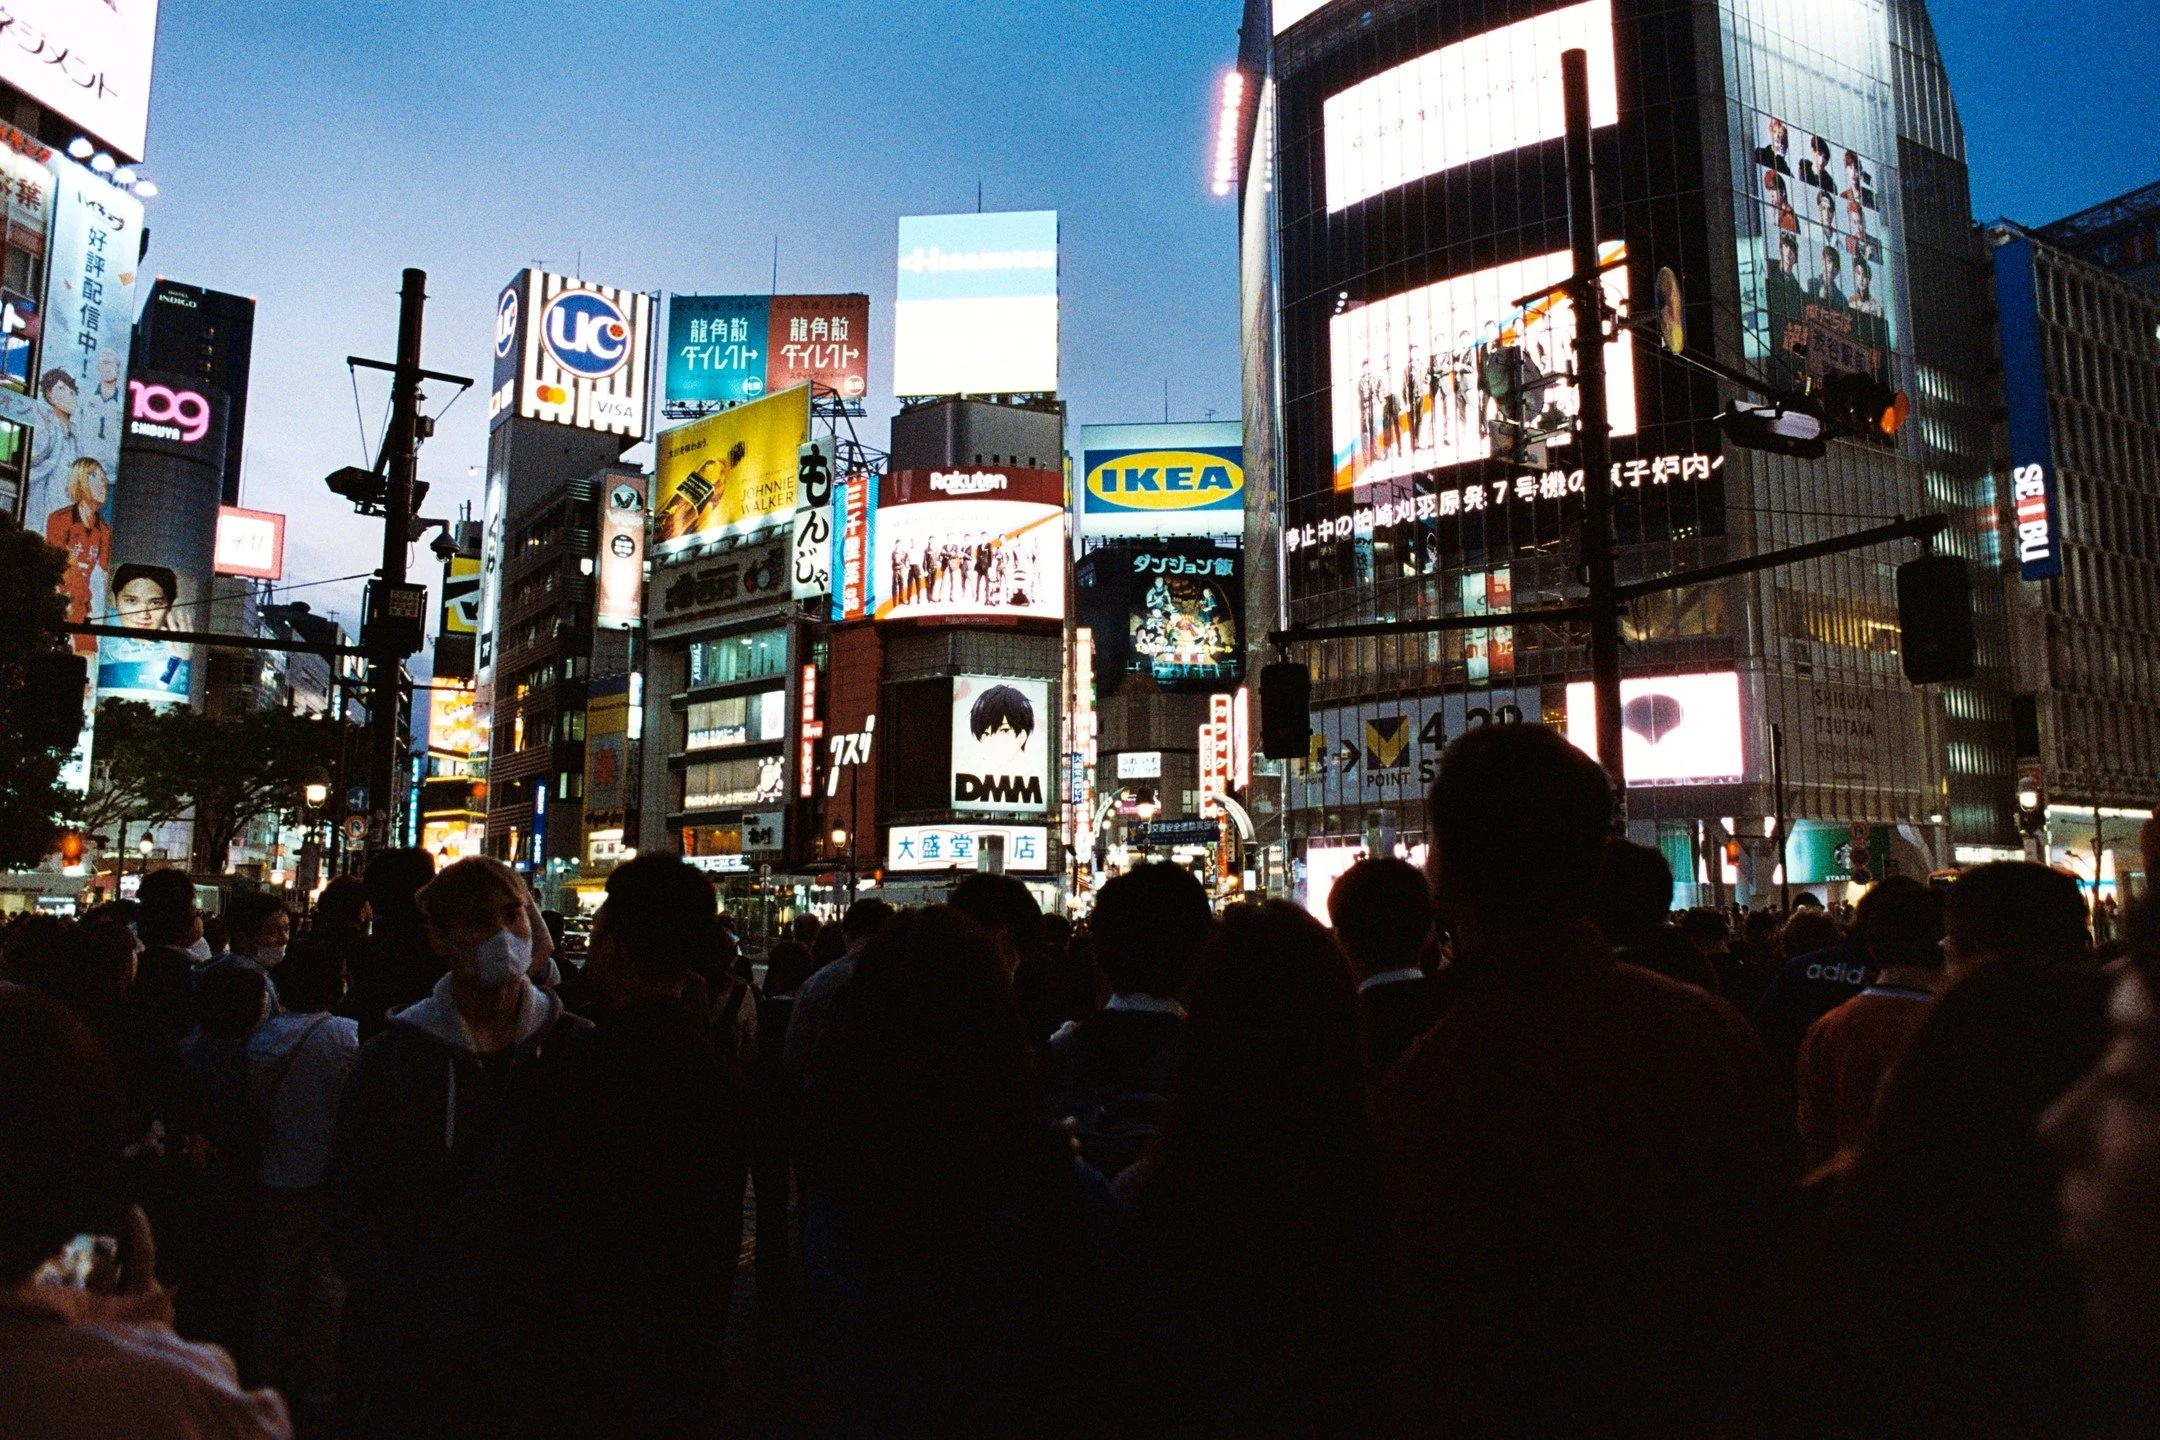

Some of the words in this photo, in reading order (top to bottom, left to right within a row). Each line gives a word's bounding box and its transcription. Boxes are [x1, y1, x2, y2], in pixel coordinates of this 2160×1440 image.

[157, 294, 198, 309] INDIGO
[551, 306, 630, 361] UC
[690, 317, 748, 344] 龍角散
[790, 316, 850, 343] 龍角散
[129, 380, 211, 443] 109
[597, 400, 634, 419] VISA
[131, 421, 181, 441] SHIBUYA
[742, 476, 795, 500] JOHNNIE
[930, 470, 1008, 491] Rakuten
[1102, 465, 1235, 493] IKEA
[741, 491, 794, 515] WALKER
[2013, 463, 2050, 563] SEIBU
[794, 443, 832, 593] もんじゃ
[1133, 554, 1235, 576] ダンジョン飯
[1816, 716, 1875, 737] TSUTAYA
[954, 772, 1044, 804] DMM
[1367, 771, 1411, 788] POINT
[897, 833, 1037, 860] 大盛堂店
[1806, 963, 1866, 985] adid
